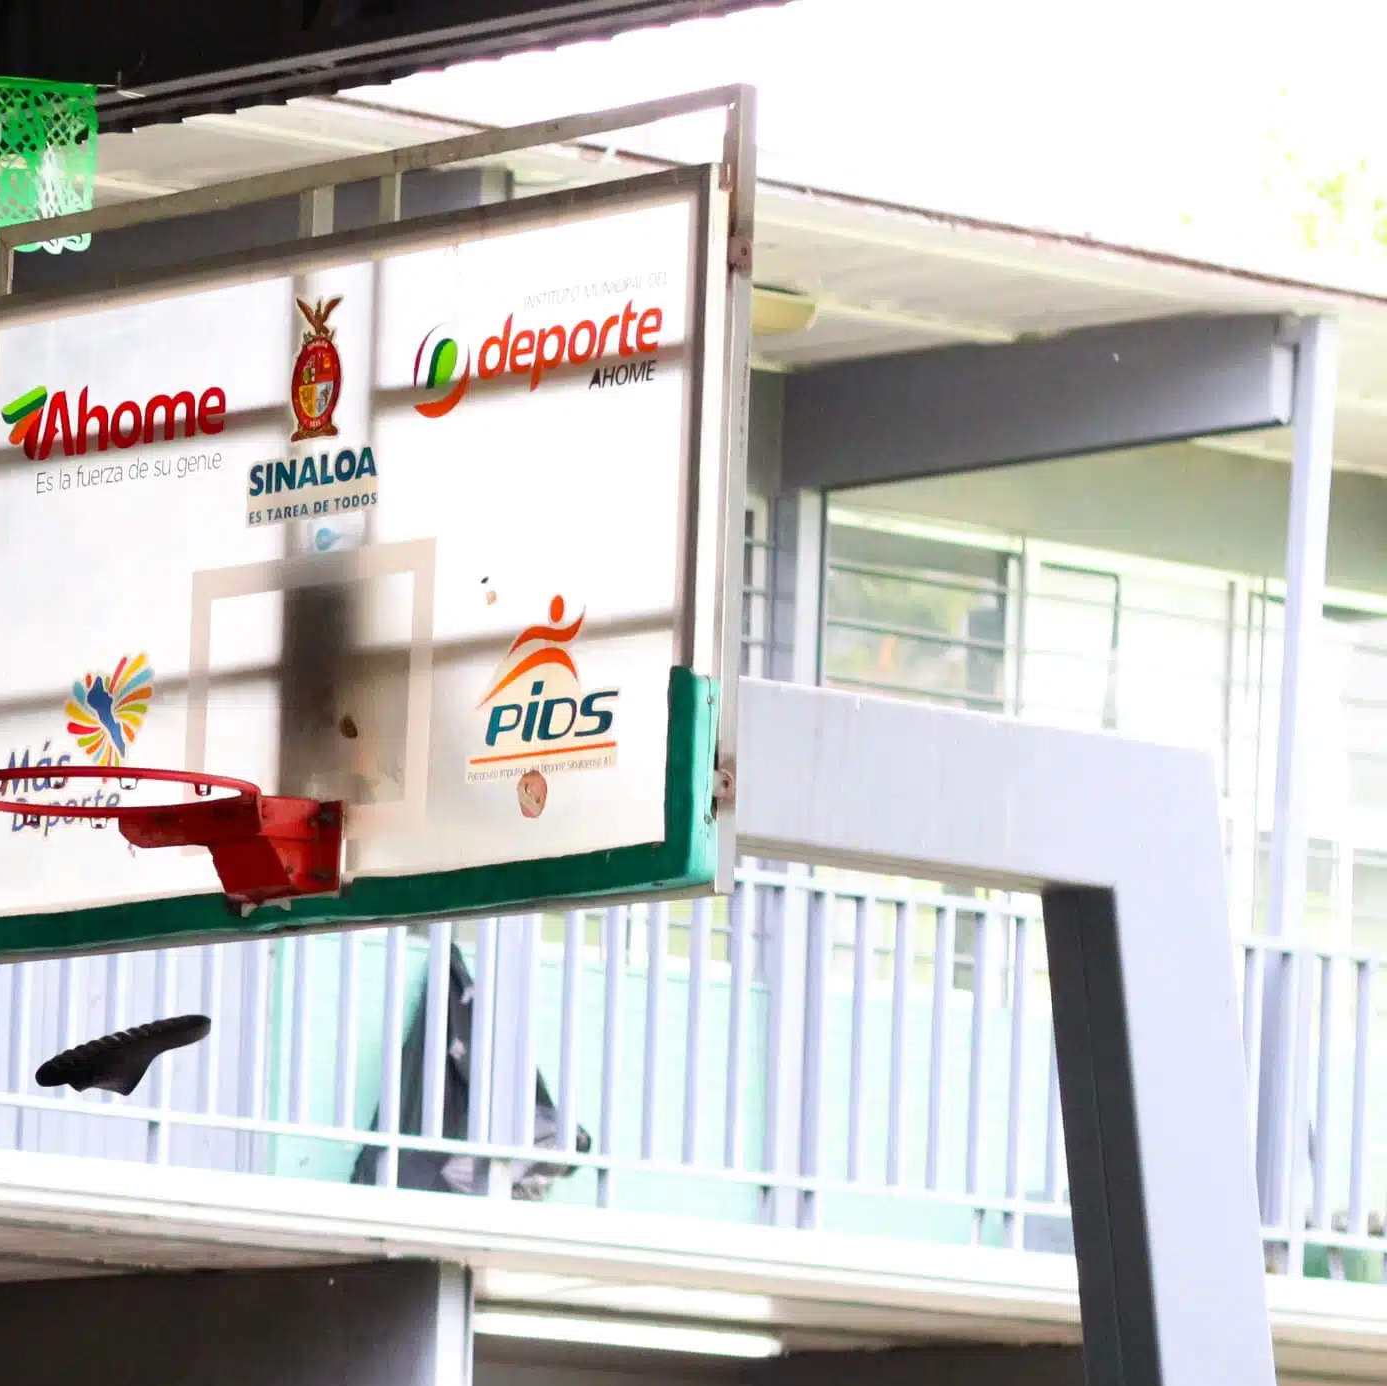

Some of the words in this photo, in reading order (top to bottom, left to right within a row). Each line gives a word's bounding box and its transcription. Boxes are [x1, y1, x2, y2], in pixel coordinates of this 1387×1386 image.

[478, 299, 662, 392] deporte
[589, 360, 657, 390] AHOME
[37, 385, 226, 460] Ahome
[36, 472, 53, 494] Es
[59, 470, 71, 490] la
[77, 465, 123, 488] fuerza
[128, 457, 149, 480] de
[153, 458, 171, 476] su
[250, 447, 377, 496] SINALOA
[249, 511, 261, 525] ES
[267, 504, 308, 521] TAREA
[313, 500, 329, 514] DE
[334, 492, 377, 511] TODOS
